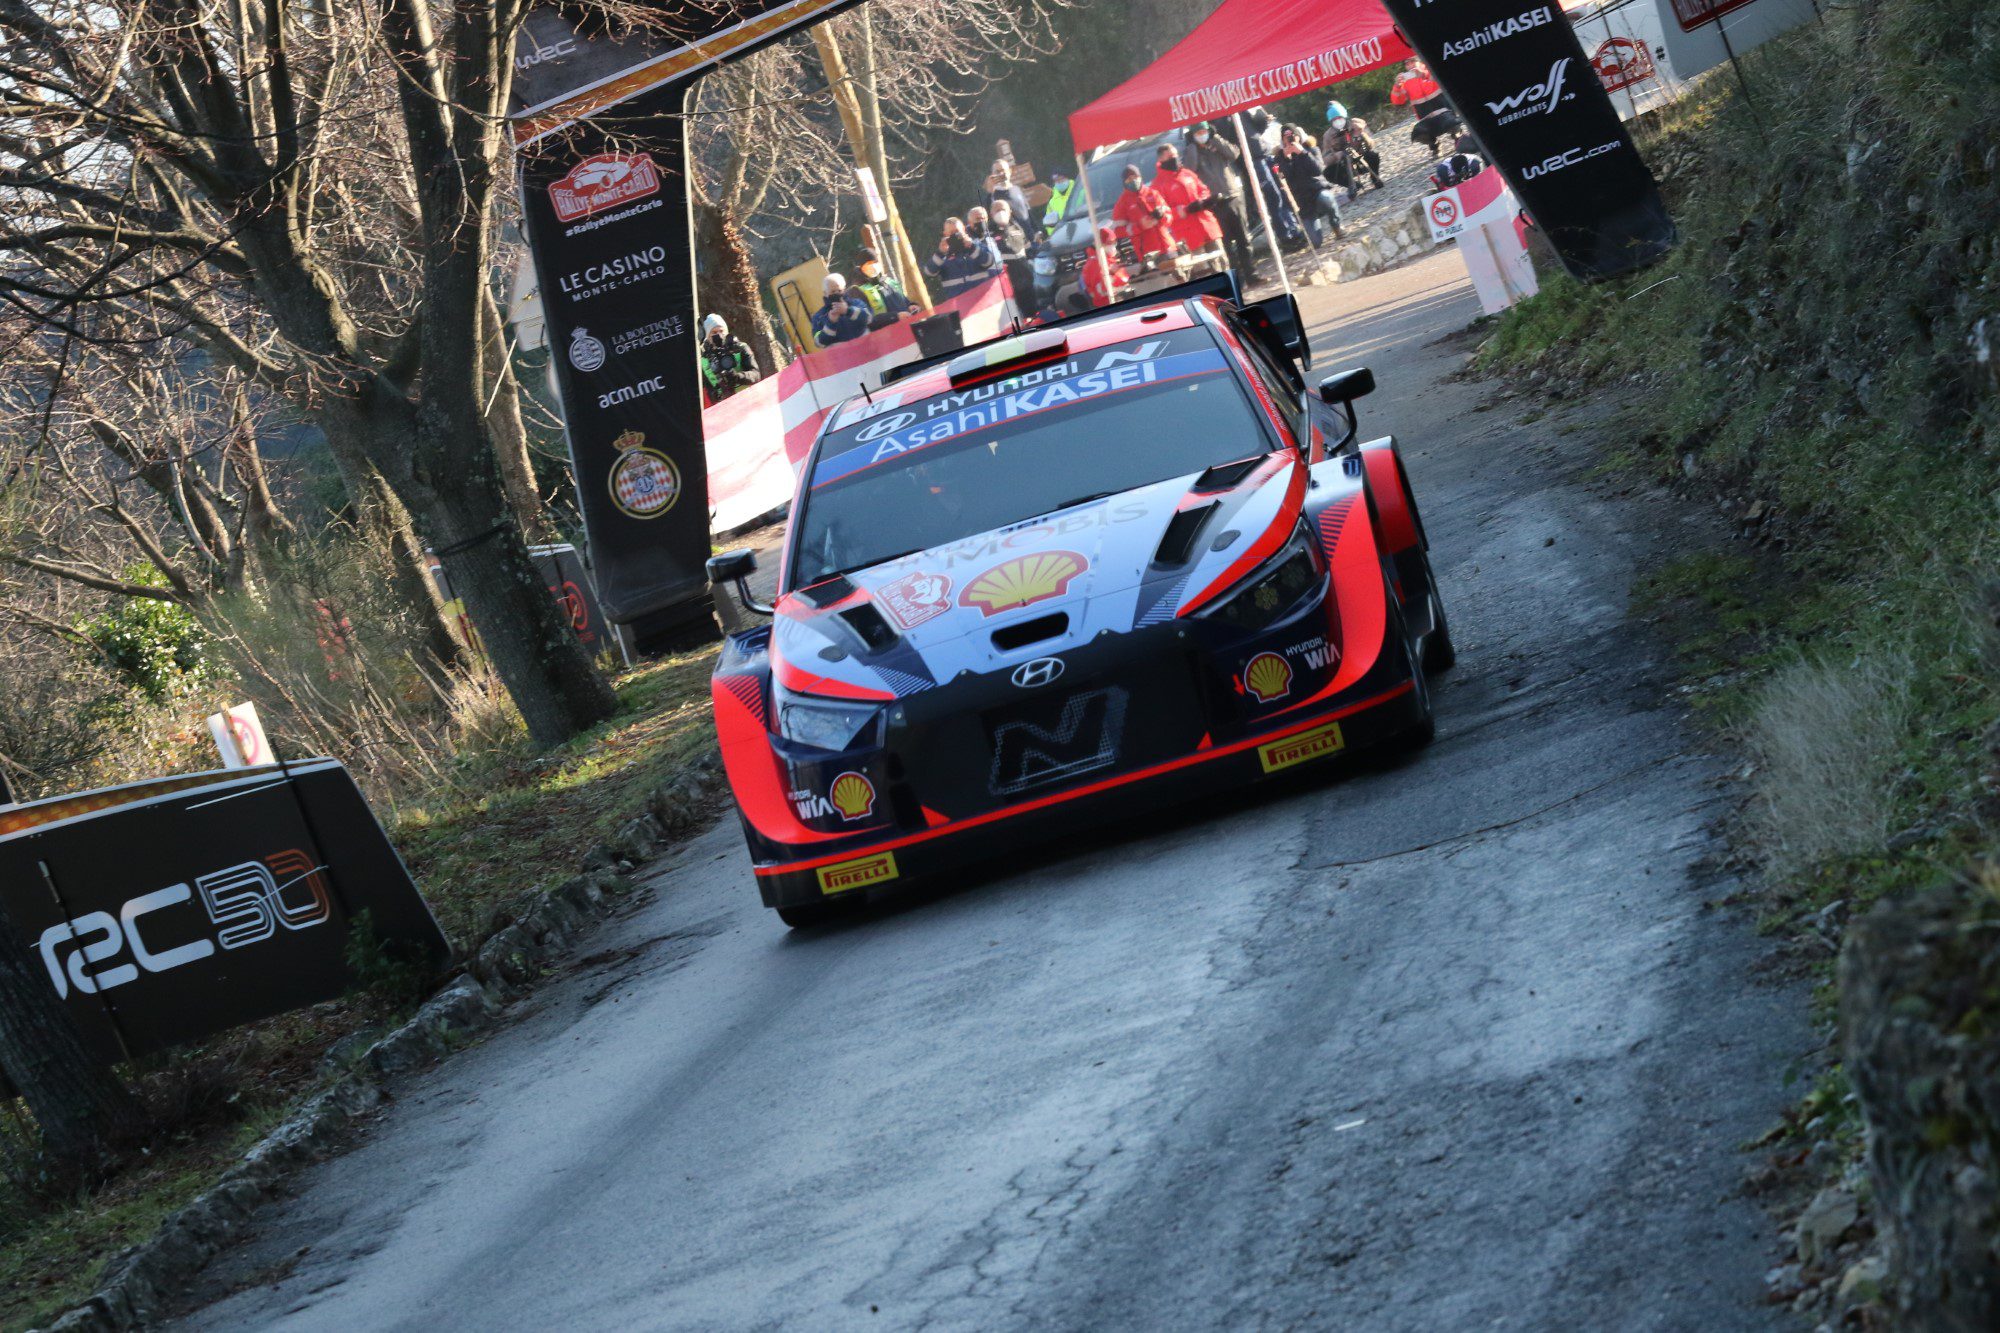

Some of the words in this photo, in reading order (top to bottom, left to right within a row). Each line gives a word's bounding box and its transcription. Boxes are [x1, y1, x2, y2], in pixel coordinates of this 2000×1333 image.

[1442, 6, 1553, 61] AsahiKASEI
[1168, 74, 1261, 123] AUTOMOBILE
[1258, 63, 1300, 96] CLUB
[1298, 56, 1320, 86] DE
[1319, 36, 1383, 79] MONACO
[1498, 101, 1548, 126] LUBRICANTS
[565, 199, 663, 237] #RallyeMonteCarlo
[560, 272, 584, 293] LE
[584, 246, 666, 284] CASINO
[611, 334, 626, 346] LA
[626, 314, 681, 341] BOUTIQUE
[615, 324, 685, 355] OFFICIELLE
[598, 375, 666, 409] acm.mc
[927, 361, 1079, 417] HYUNDAI
[870, 361, 1157, 463] AsahiKASEI
[945, 500, 1149, 569] MOBIS
[1285, 637, 1323, 657] HYUNDAI
[1266, 729, 1338, 767] PIRELLI
[823, 858, 890, 889] PIRELLI
